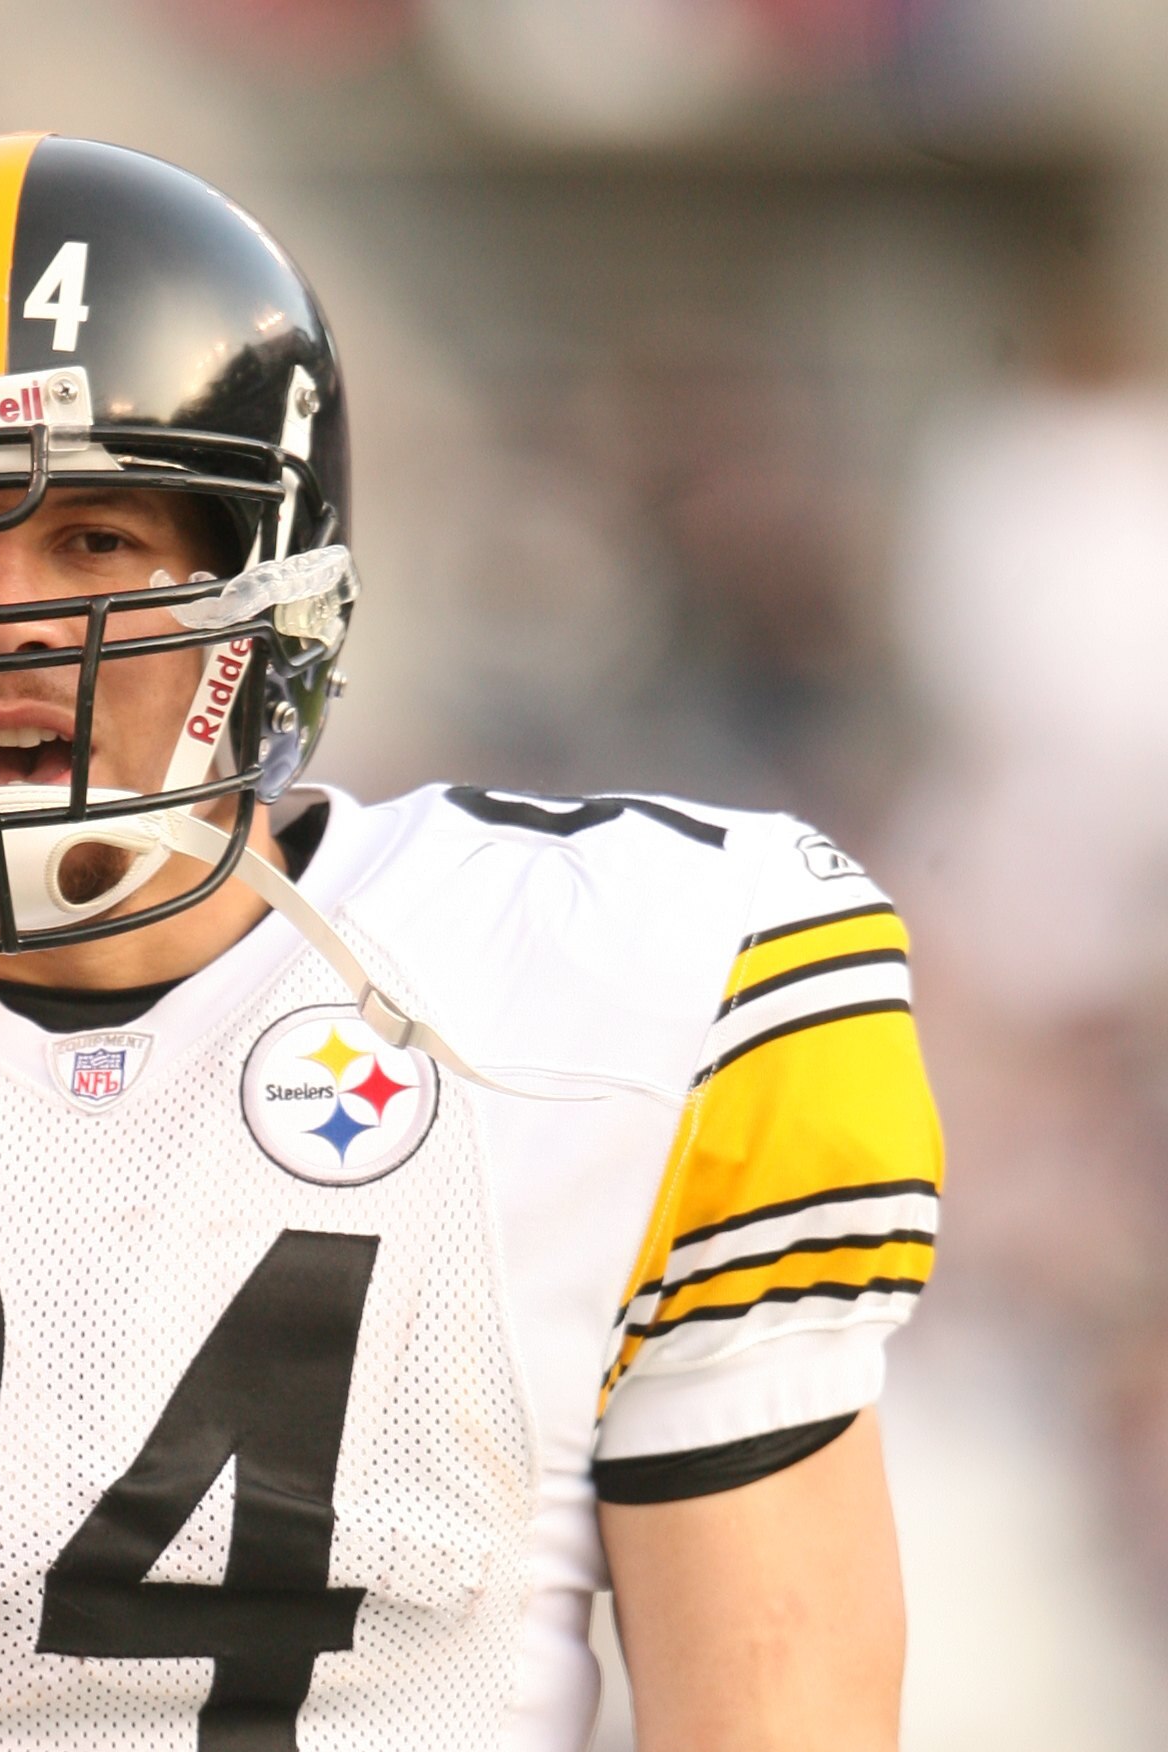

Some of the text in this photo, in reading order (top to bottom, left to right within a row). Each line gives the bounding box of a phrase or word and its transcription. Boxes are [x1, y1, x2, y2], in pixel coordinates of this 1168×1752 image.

[186, 637, 254, 746] Ridde
[74, 1070, 119, 1096] NFL
[265, 1082, 334, 1101] Steelers
